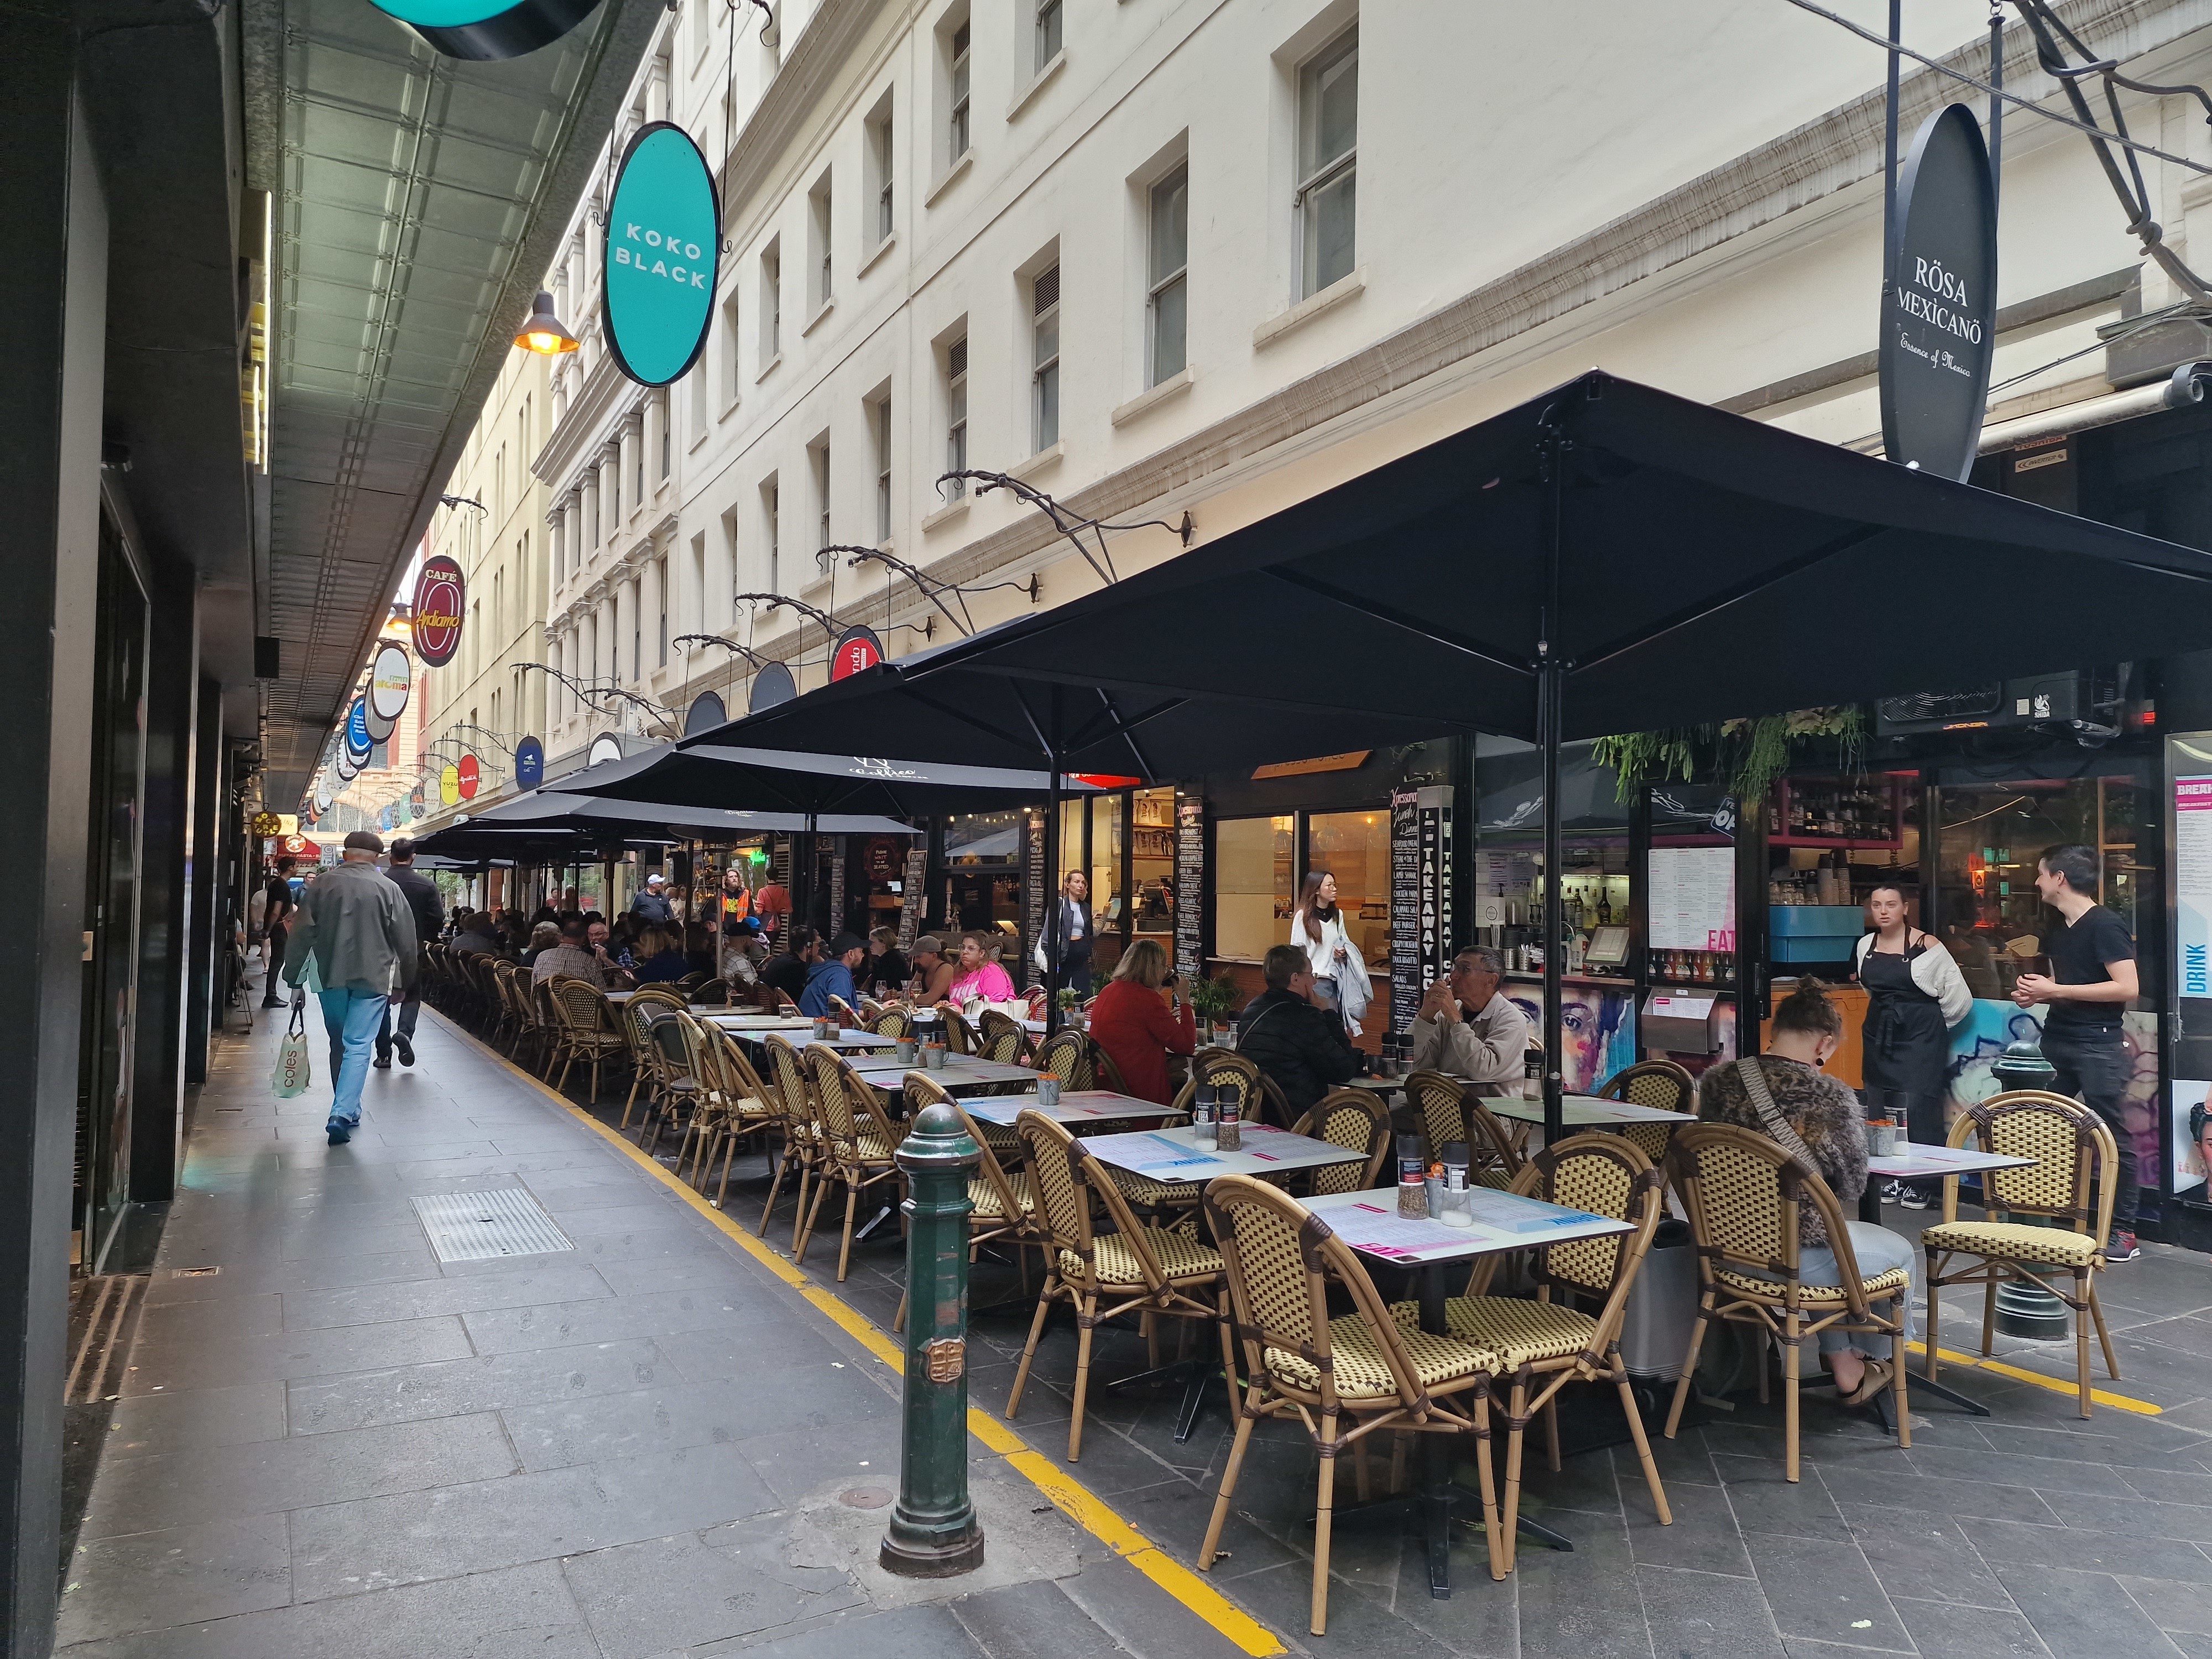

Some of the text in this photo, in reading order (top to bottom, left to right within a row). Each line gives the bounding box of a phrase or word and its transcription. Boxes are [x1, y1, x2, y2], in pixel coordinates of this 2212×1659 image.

[627, 223, 701, 259] KOKO
[615, 247, 706, 289] BLACK
[1901, 332, 1971, 377] Essence of Mexico
[425, 569, 457, 582] CAFÉ
[416, 609, 460, 629] Andiamo
[375, 680, 407, 691] aroma
[460, 774, 477, 784] Grill'd
[1394, 804, 1415, 828] Lunch
[1421, 847, 1436, 956] TAKEAWAY
[1442, 852, 1452, 948] TAKEAWAY
[1393, 921, 1401, 929] BEEF
[1392, 974, 1407, 984] SALADS
[2186, 943, 2206, 993] DRINK
[284, 1050, 298, 1088] coles
[1543, 1214, 1603, 1225] DRINK
[1355, 1243, 1405, 1255] EAT
